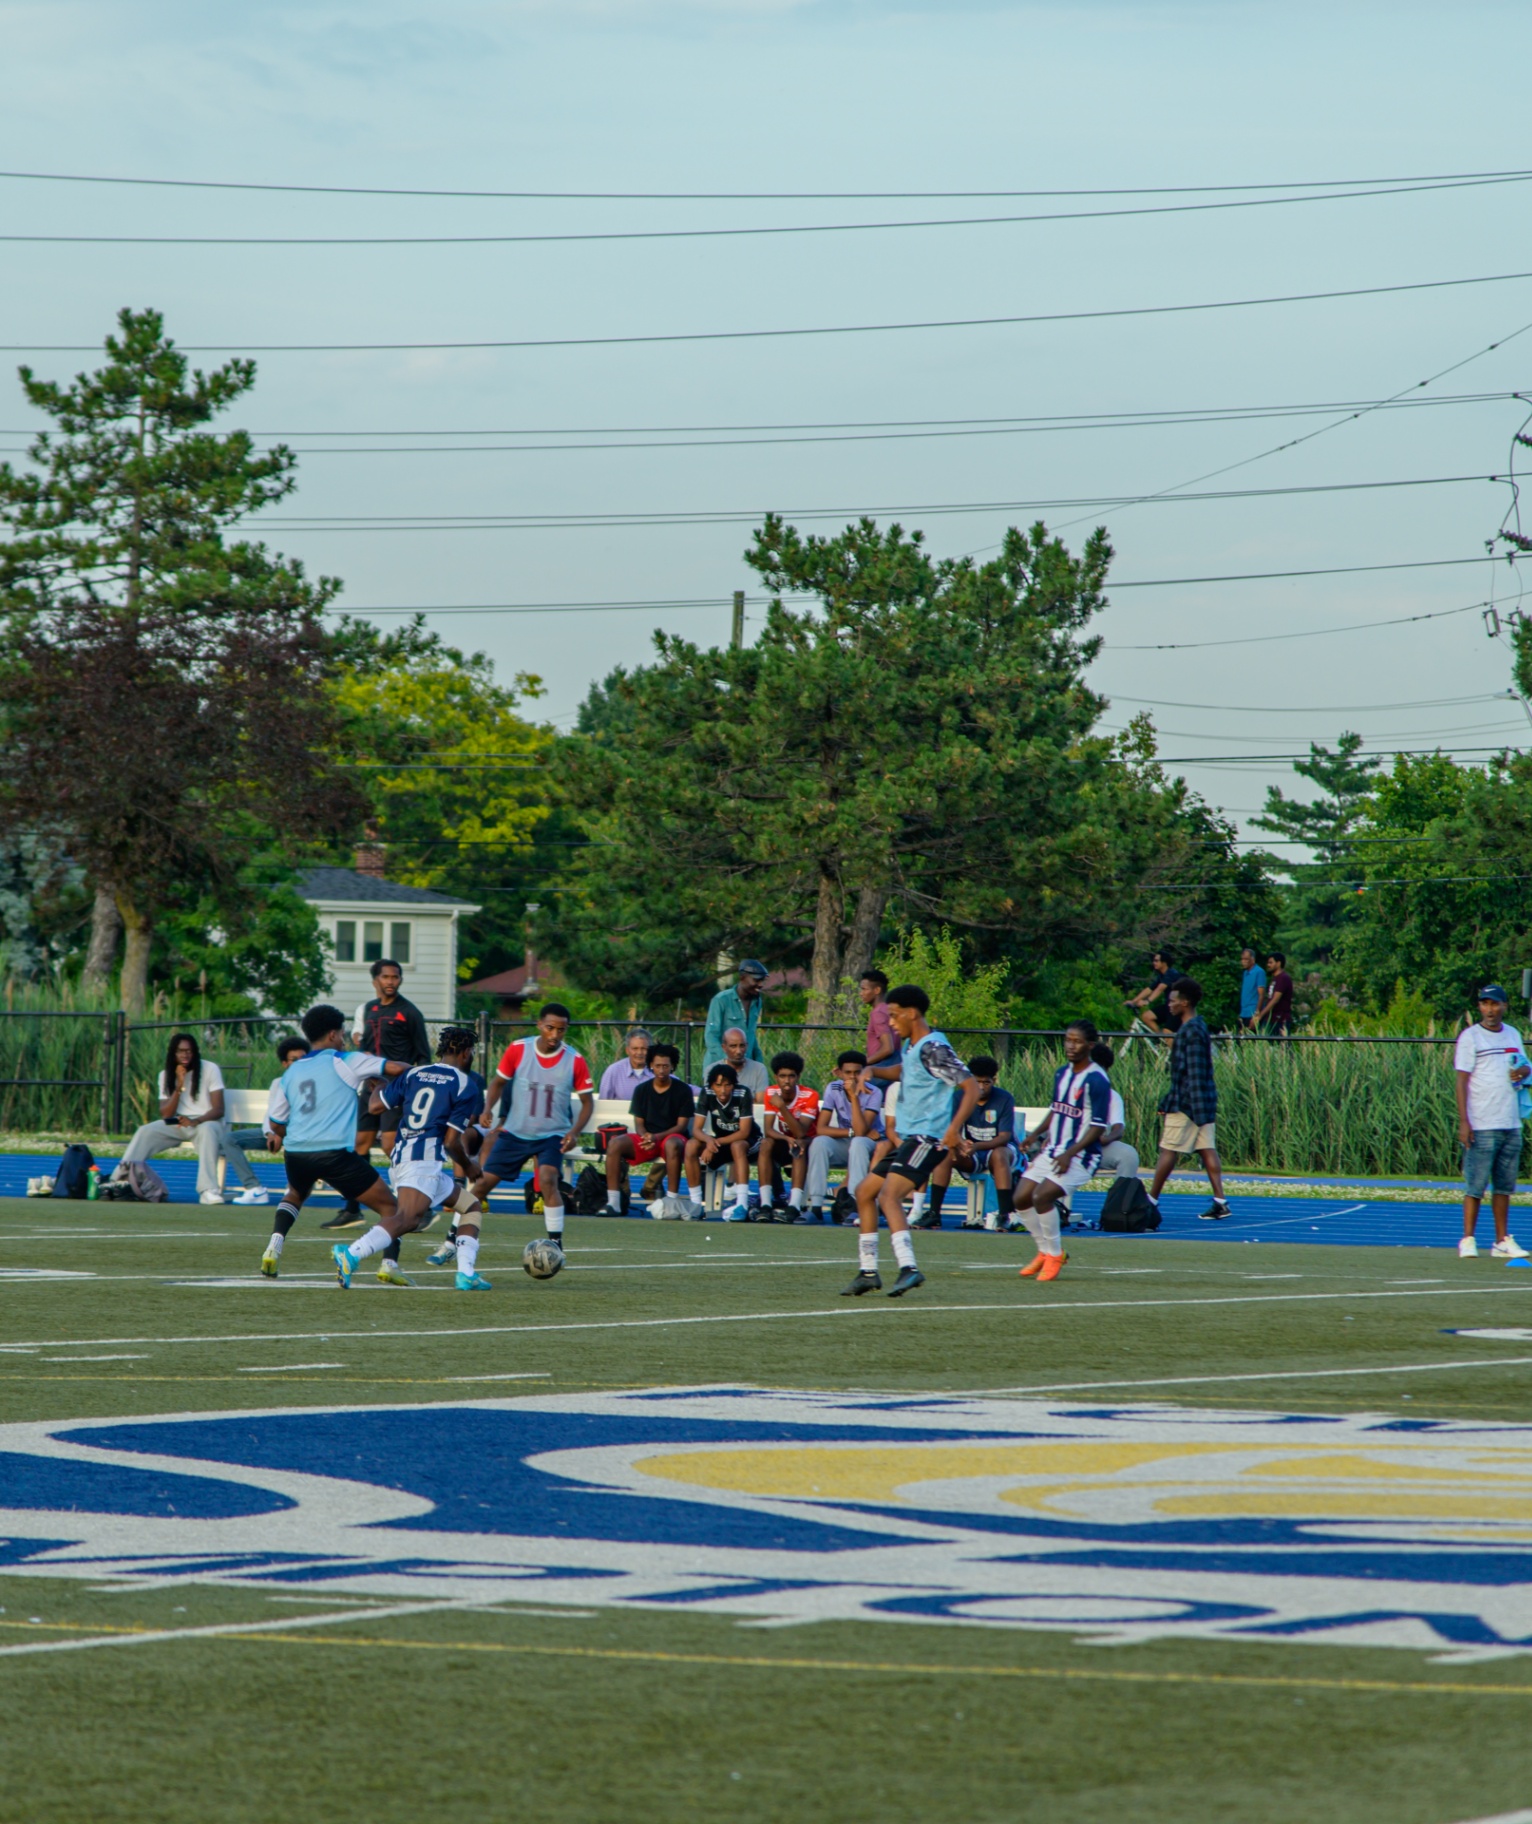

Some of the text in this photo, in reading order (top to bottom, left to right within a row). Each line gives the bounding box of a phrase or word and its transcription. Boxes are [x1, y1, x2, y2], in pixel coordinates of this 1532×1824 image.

[298, 1078, 316, 1115] 3
[408, 1086, 435, 1130] 9
[529, 1082, 555, 1118] 11
[1053, 1101, 1083, 1118] NITED
